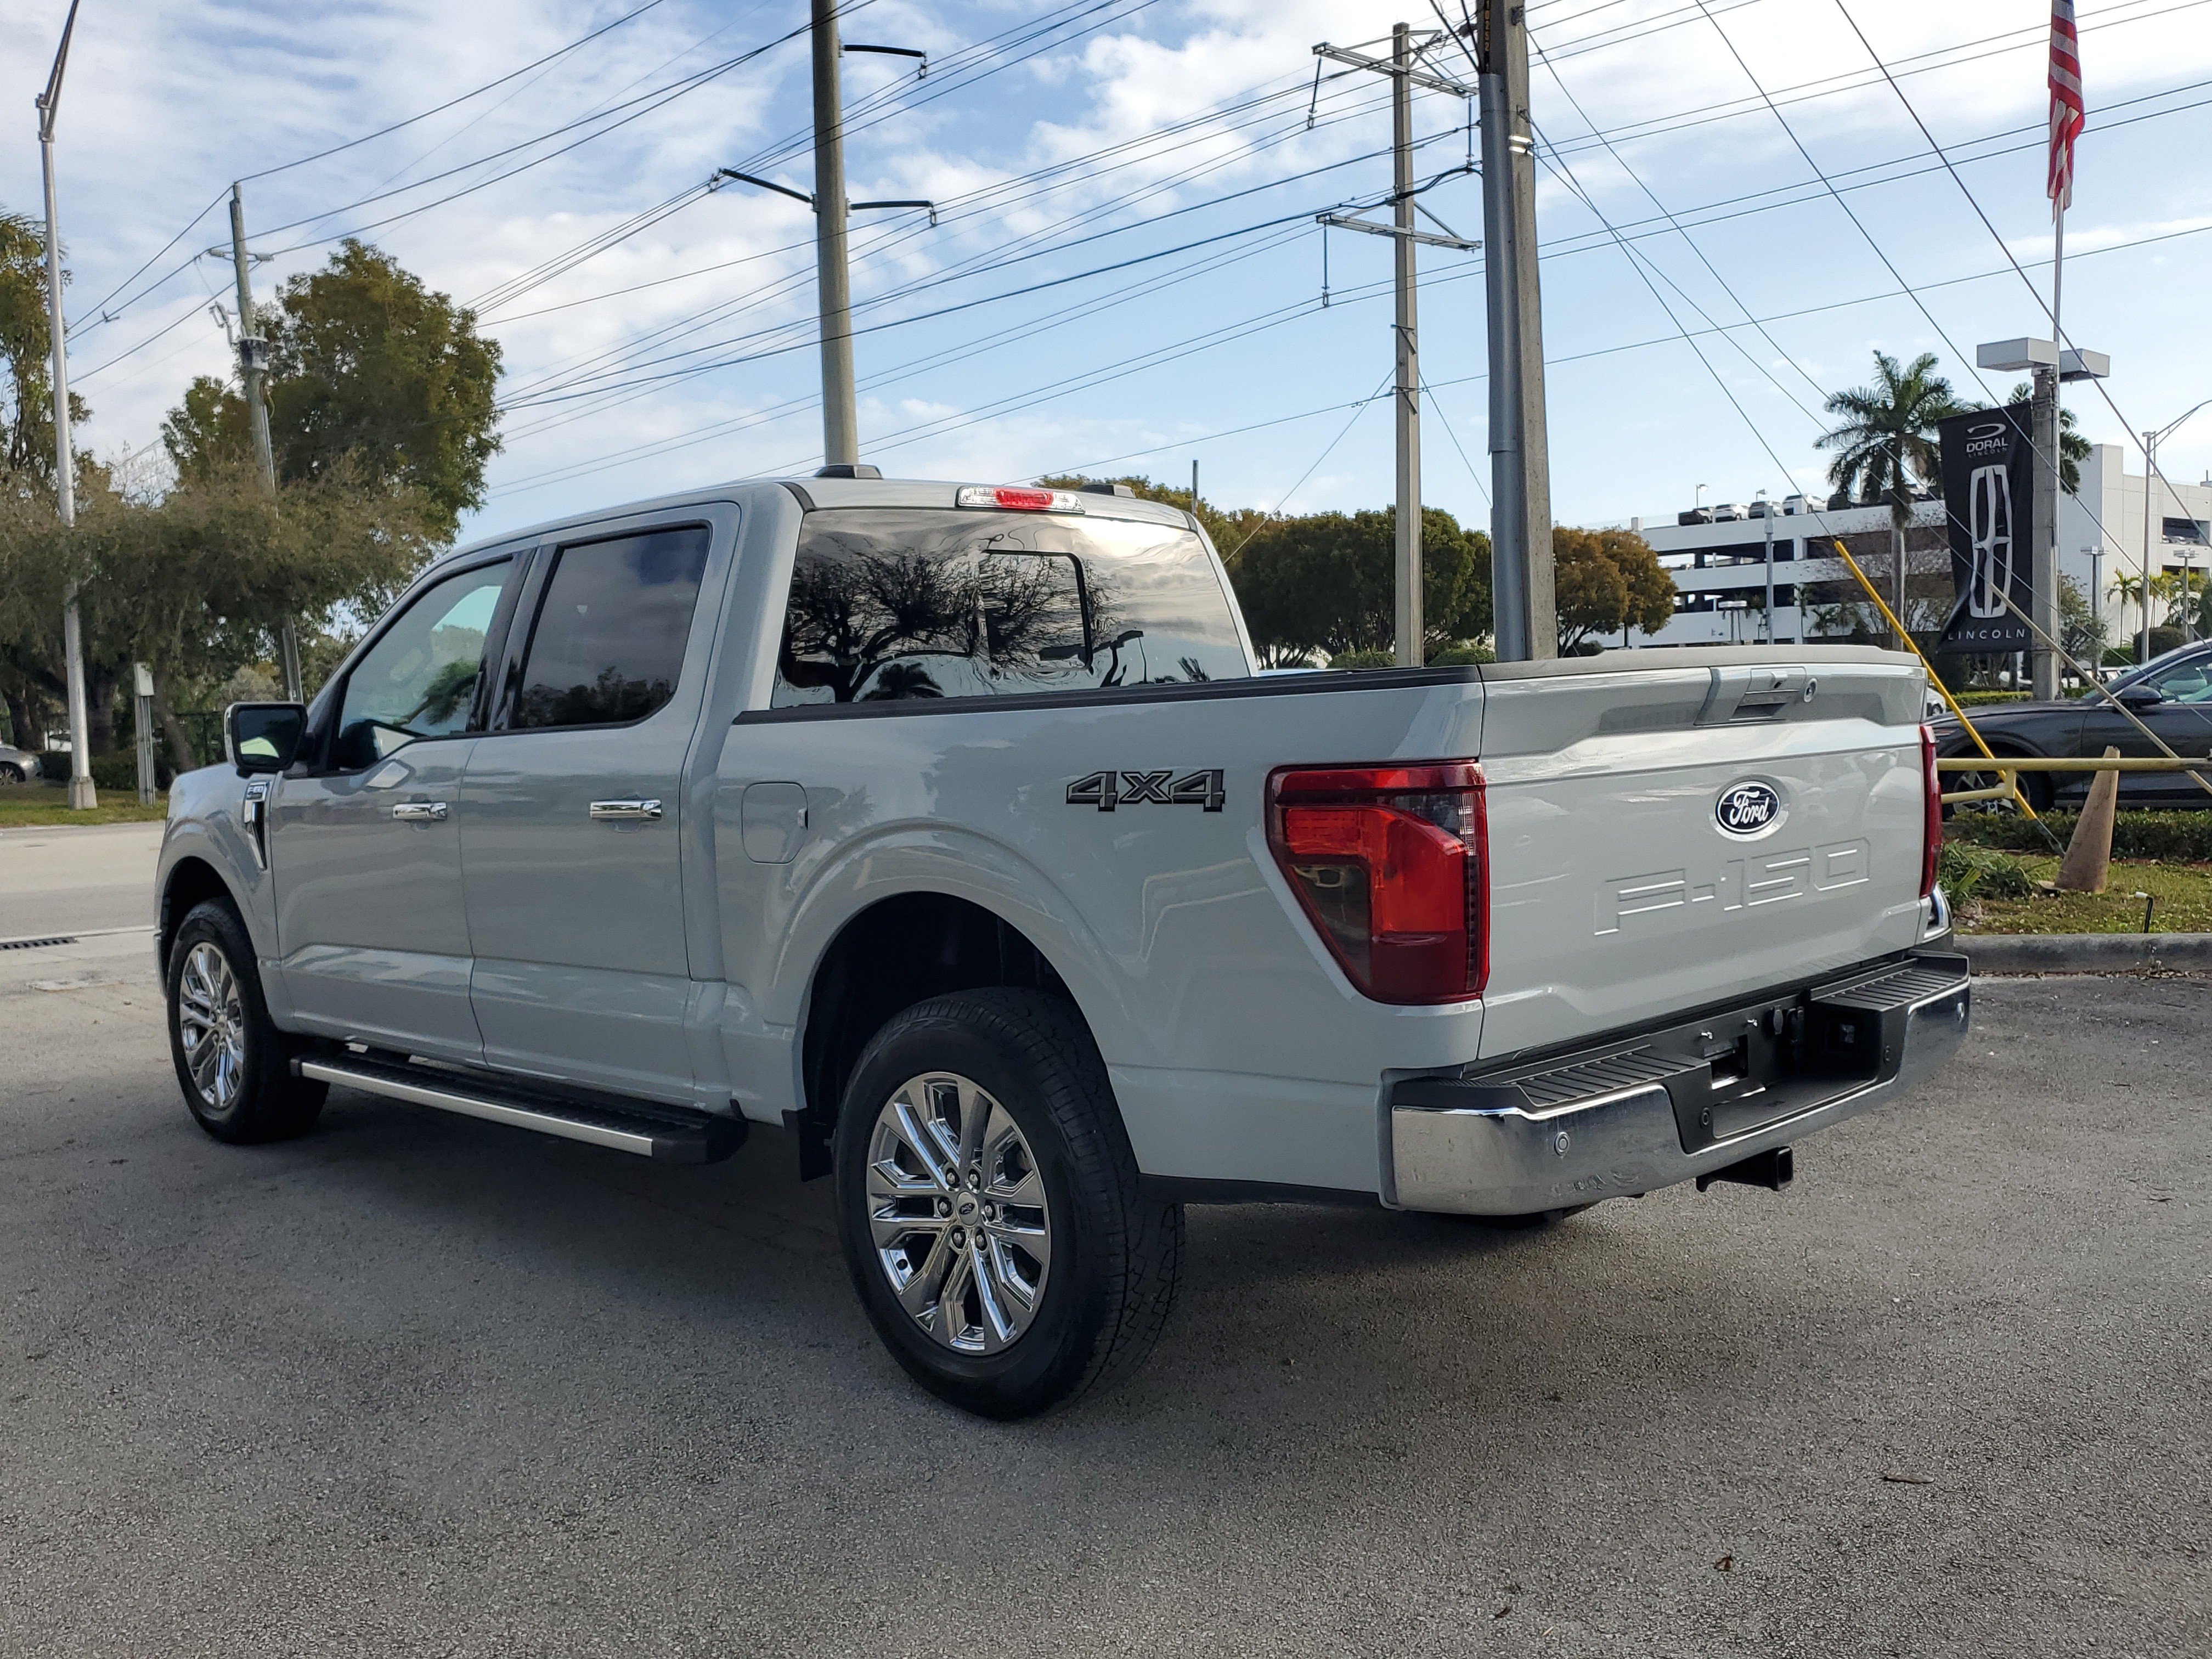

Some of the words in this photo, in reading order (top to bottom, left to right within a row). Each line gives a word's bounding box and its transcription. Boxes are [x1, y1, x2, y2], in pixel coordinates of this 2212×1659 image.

[1966, 437, 2008, 453] DORAL
[1948, 628, 2025, 640] LINCOLN
[1729, 791, 1769, 825] Ford
[1594, 837, 1870, 935] F-150
